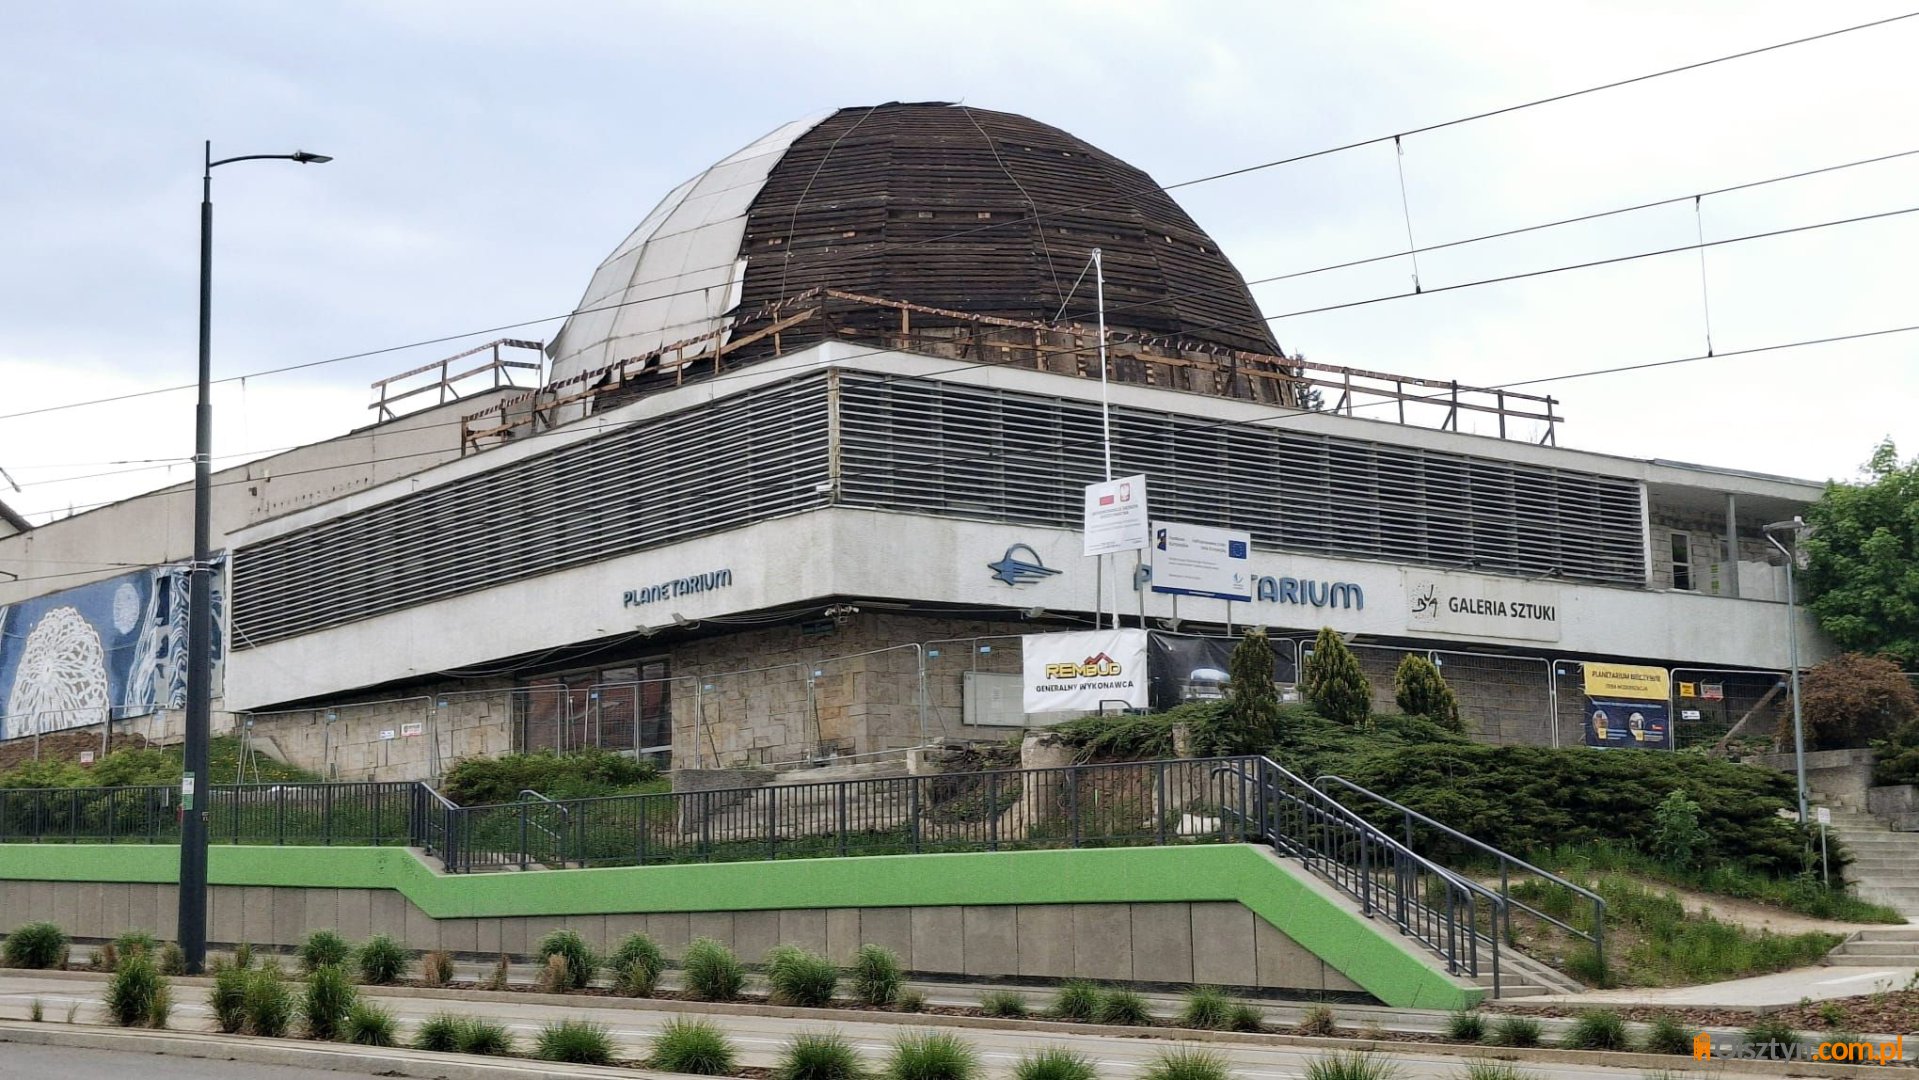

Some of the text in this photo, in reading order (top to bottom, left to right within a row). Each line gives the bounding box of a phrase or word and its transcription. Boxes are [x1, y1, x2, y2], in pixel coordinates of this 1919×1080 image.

[1448, 596, 1556, 621] GALERIA SZTUKI
[1045, 661, 1122, 679] REMBUD
[1591, 670, 1630, 681] PLANETARIUM
[1035, 680, 1135, 693] GENERALNY WYKONAWCA
